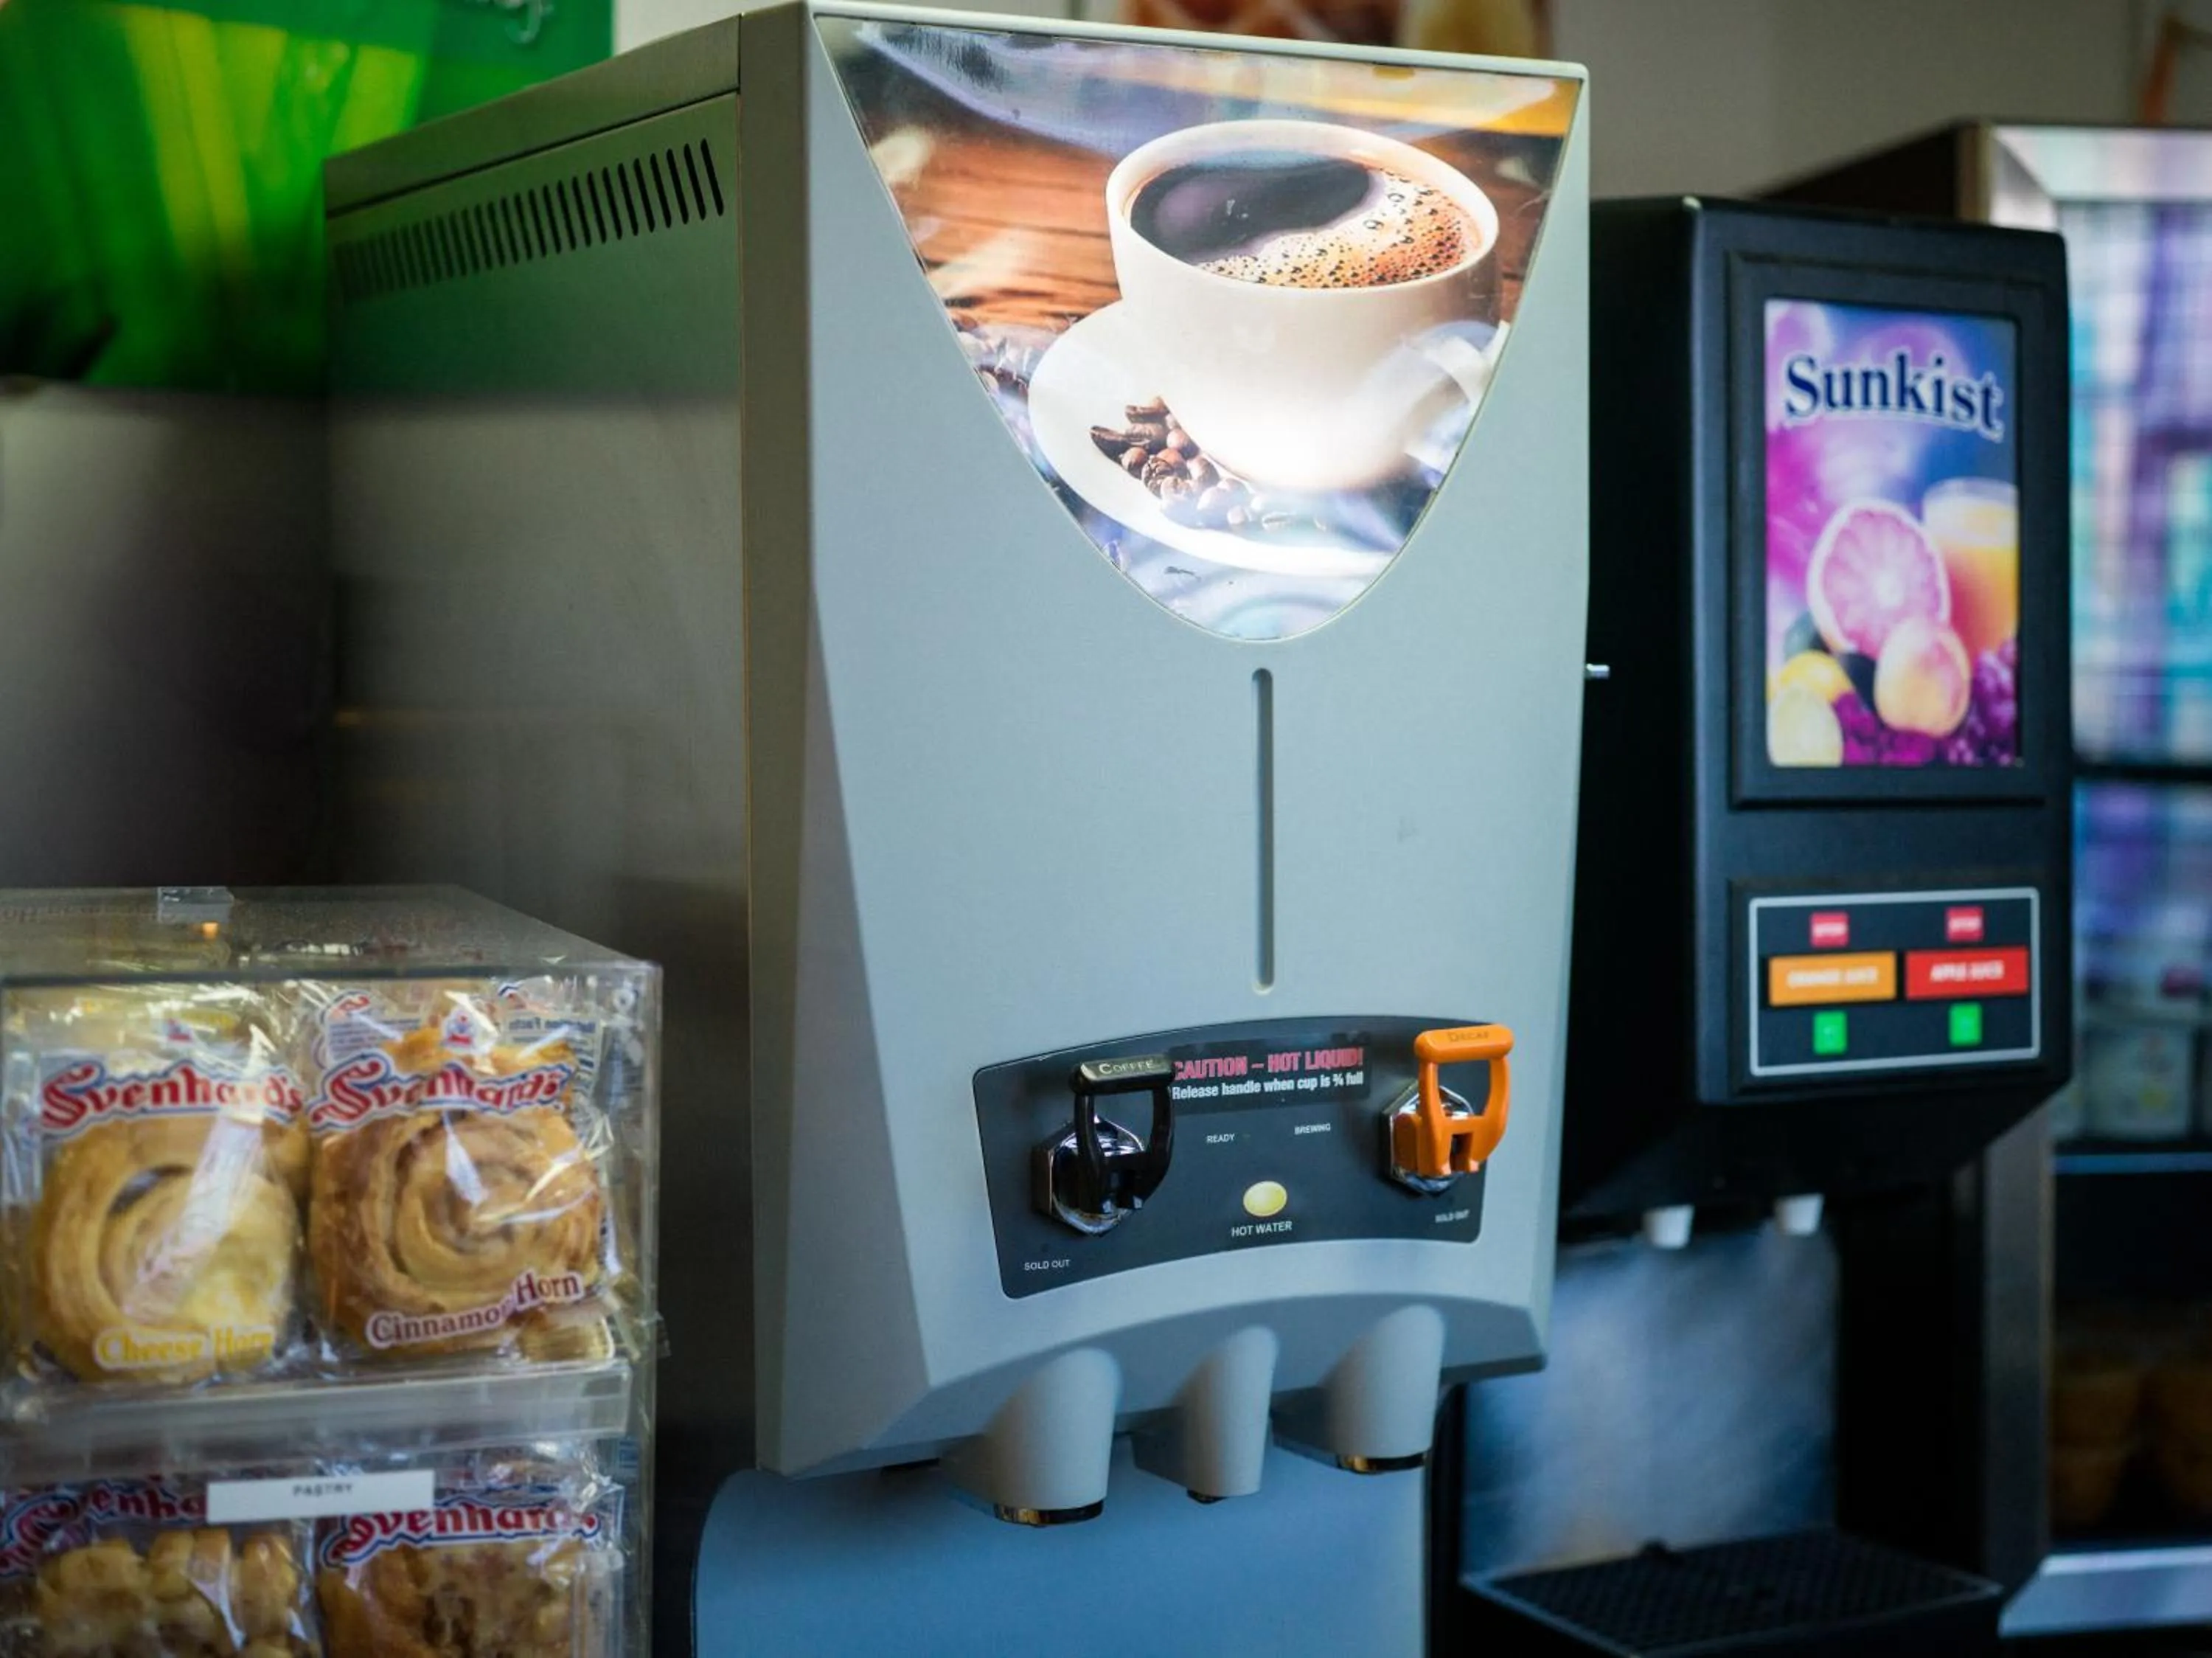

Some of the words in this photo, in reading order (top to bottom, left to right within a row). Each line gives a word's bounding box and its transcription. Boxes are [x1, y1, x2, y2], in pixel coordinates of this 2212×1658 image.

[1783, 350, 2003, 438] Sunkist
[1173, 1055, 1248, 1081] CAUTION
[1267, 1052, 1301, 1072] HOT
[1304, 1047, 1363, 1070] LIQUID!
[1172, 1084, 1219, 1100] Release
[1221, 1080, 1261, 1096] handle
[1264, 1078, 1295, 1092] when
[1297, 1077, 1318, 1091] cup
[1320, 1074, 1331, 1088] is
[1346, 1070, 1363, 1086] full
[1206, 1133, 1235, 1144] READY
[1294, 1123, 1331, 1136] BREWING
[1231, 1225, 1253, 1237] HOT
[1256, 1221, 1293, 1234] WATER
[1024, 1260, 1049, 1271] SOLD
[1051, 1258, 1071, 1268] OUT
[516, 1271, 580, 1305] Horn
